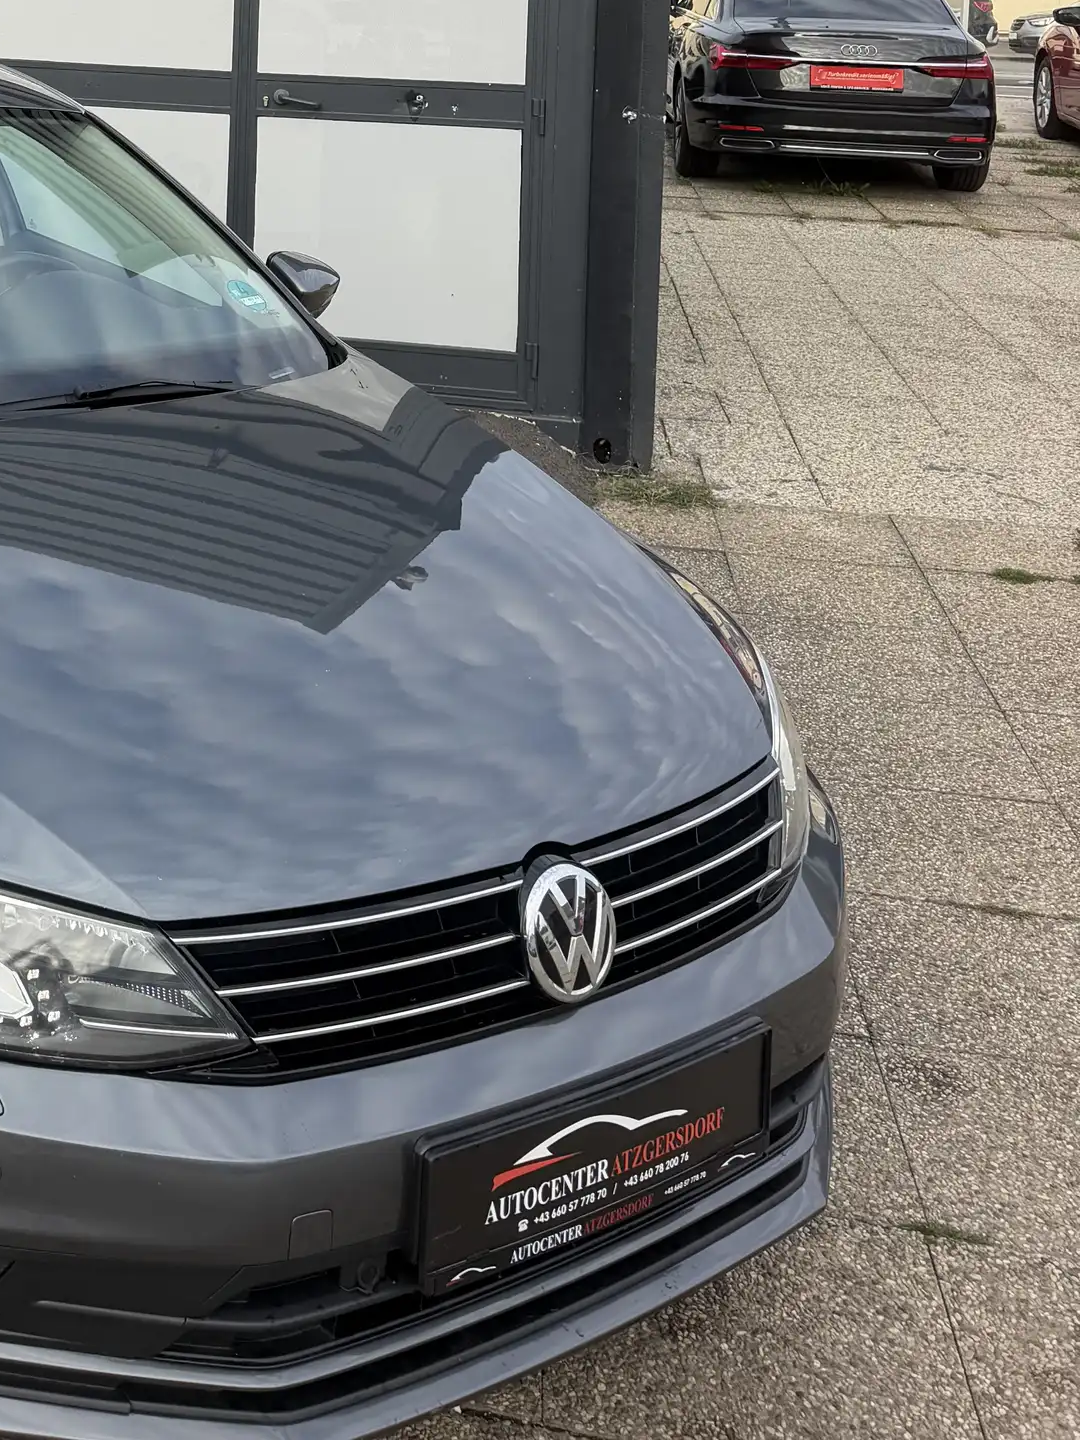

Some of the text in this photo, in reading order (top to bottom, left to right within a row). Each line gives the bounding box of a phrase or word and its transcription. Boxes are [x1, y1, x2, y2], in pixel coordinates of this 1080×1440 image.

[484, 1106, 725, 1226] AUTOCENTER ATZGERSDORF
[533, 1211, 550, 1225] +43
[551, 1204, 567, 1219] 660
[568, 1199, 579, 1212] 57
[580, 1193, 596, 1207] 778
[597, 1188, 608, 1200] 70
[623, 1174, 638, 1187] +43
[639, 1168, 654, 1182] 660
[654, 1163, 665, 1175] 78
[665, 1156, 679, 1171] 200
[509, 1193, 655, 1265] AUTOCENTER ATZGERSDORF
